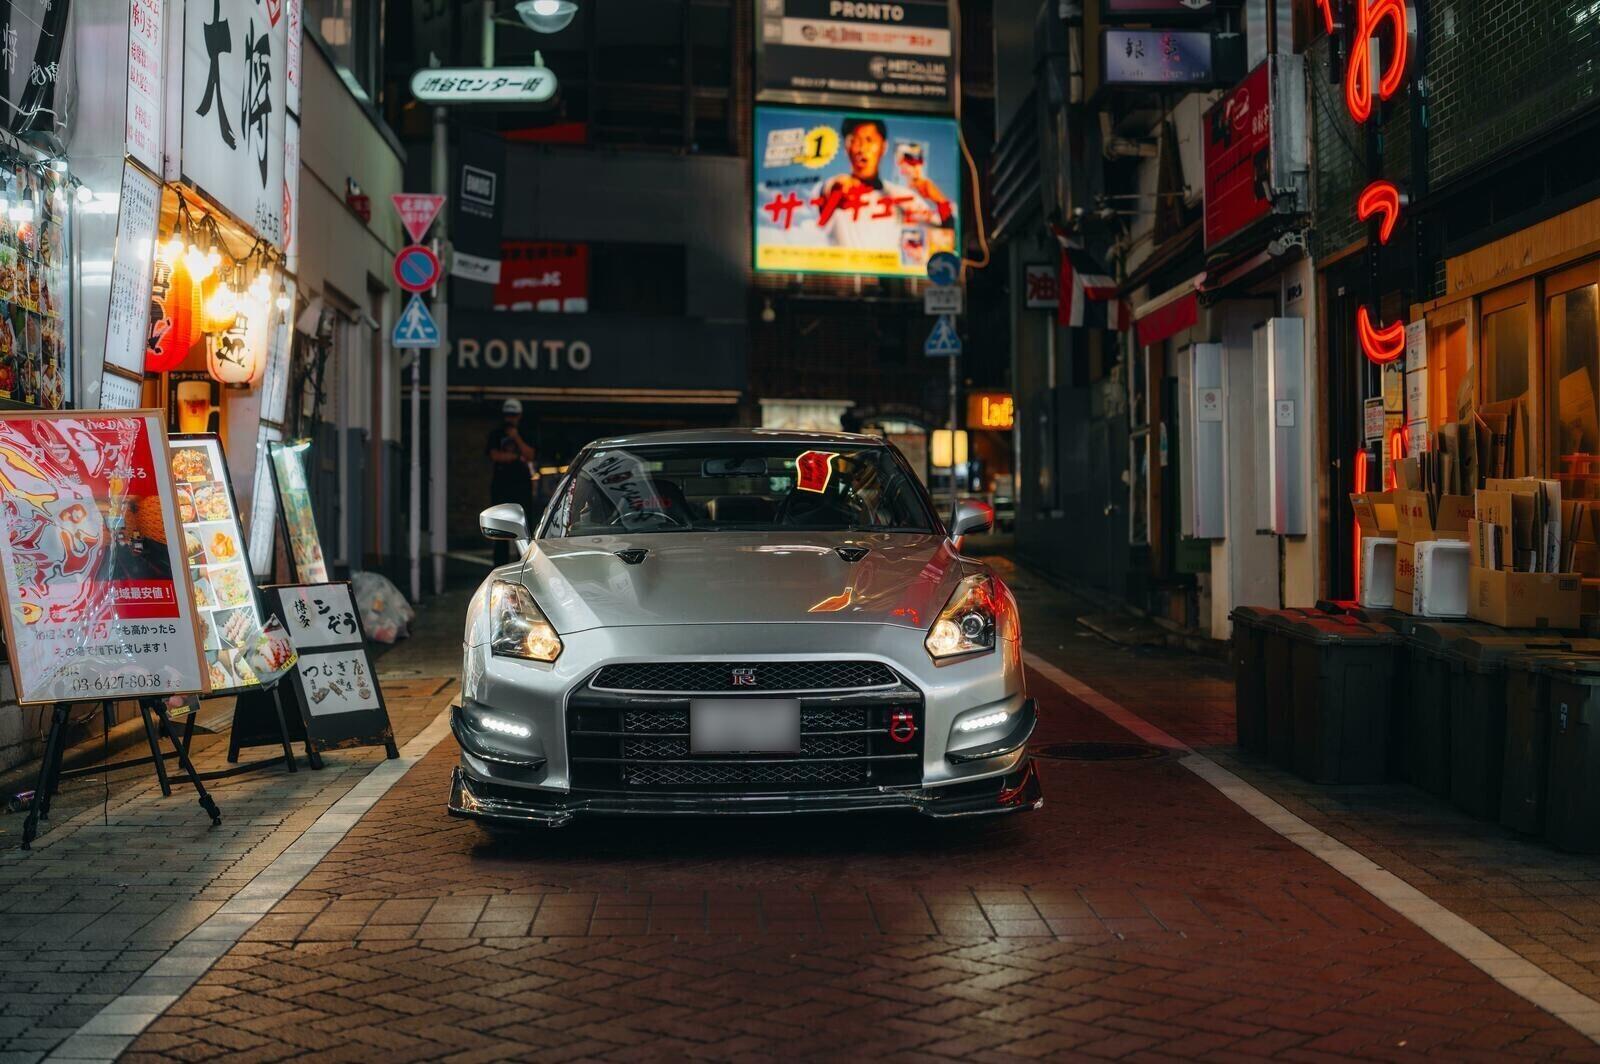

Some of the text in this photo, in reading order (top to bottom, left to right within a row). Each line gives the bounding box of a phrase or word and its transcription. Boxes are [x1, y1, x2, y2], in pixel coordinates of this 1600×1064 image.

[829, 0, 905, 21] PRONTO
[419, 77, 544, 93] 渋谷センター街
[446, 337, 592, 371] RONTO
